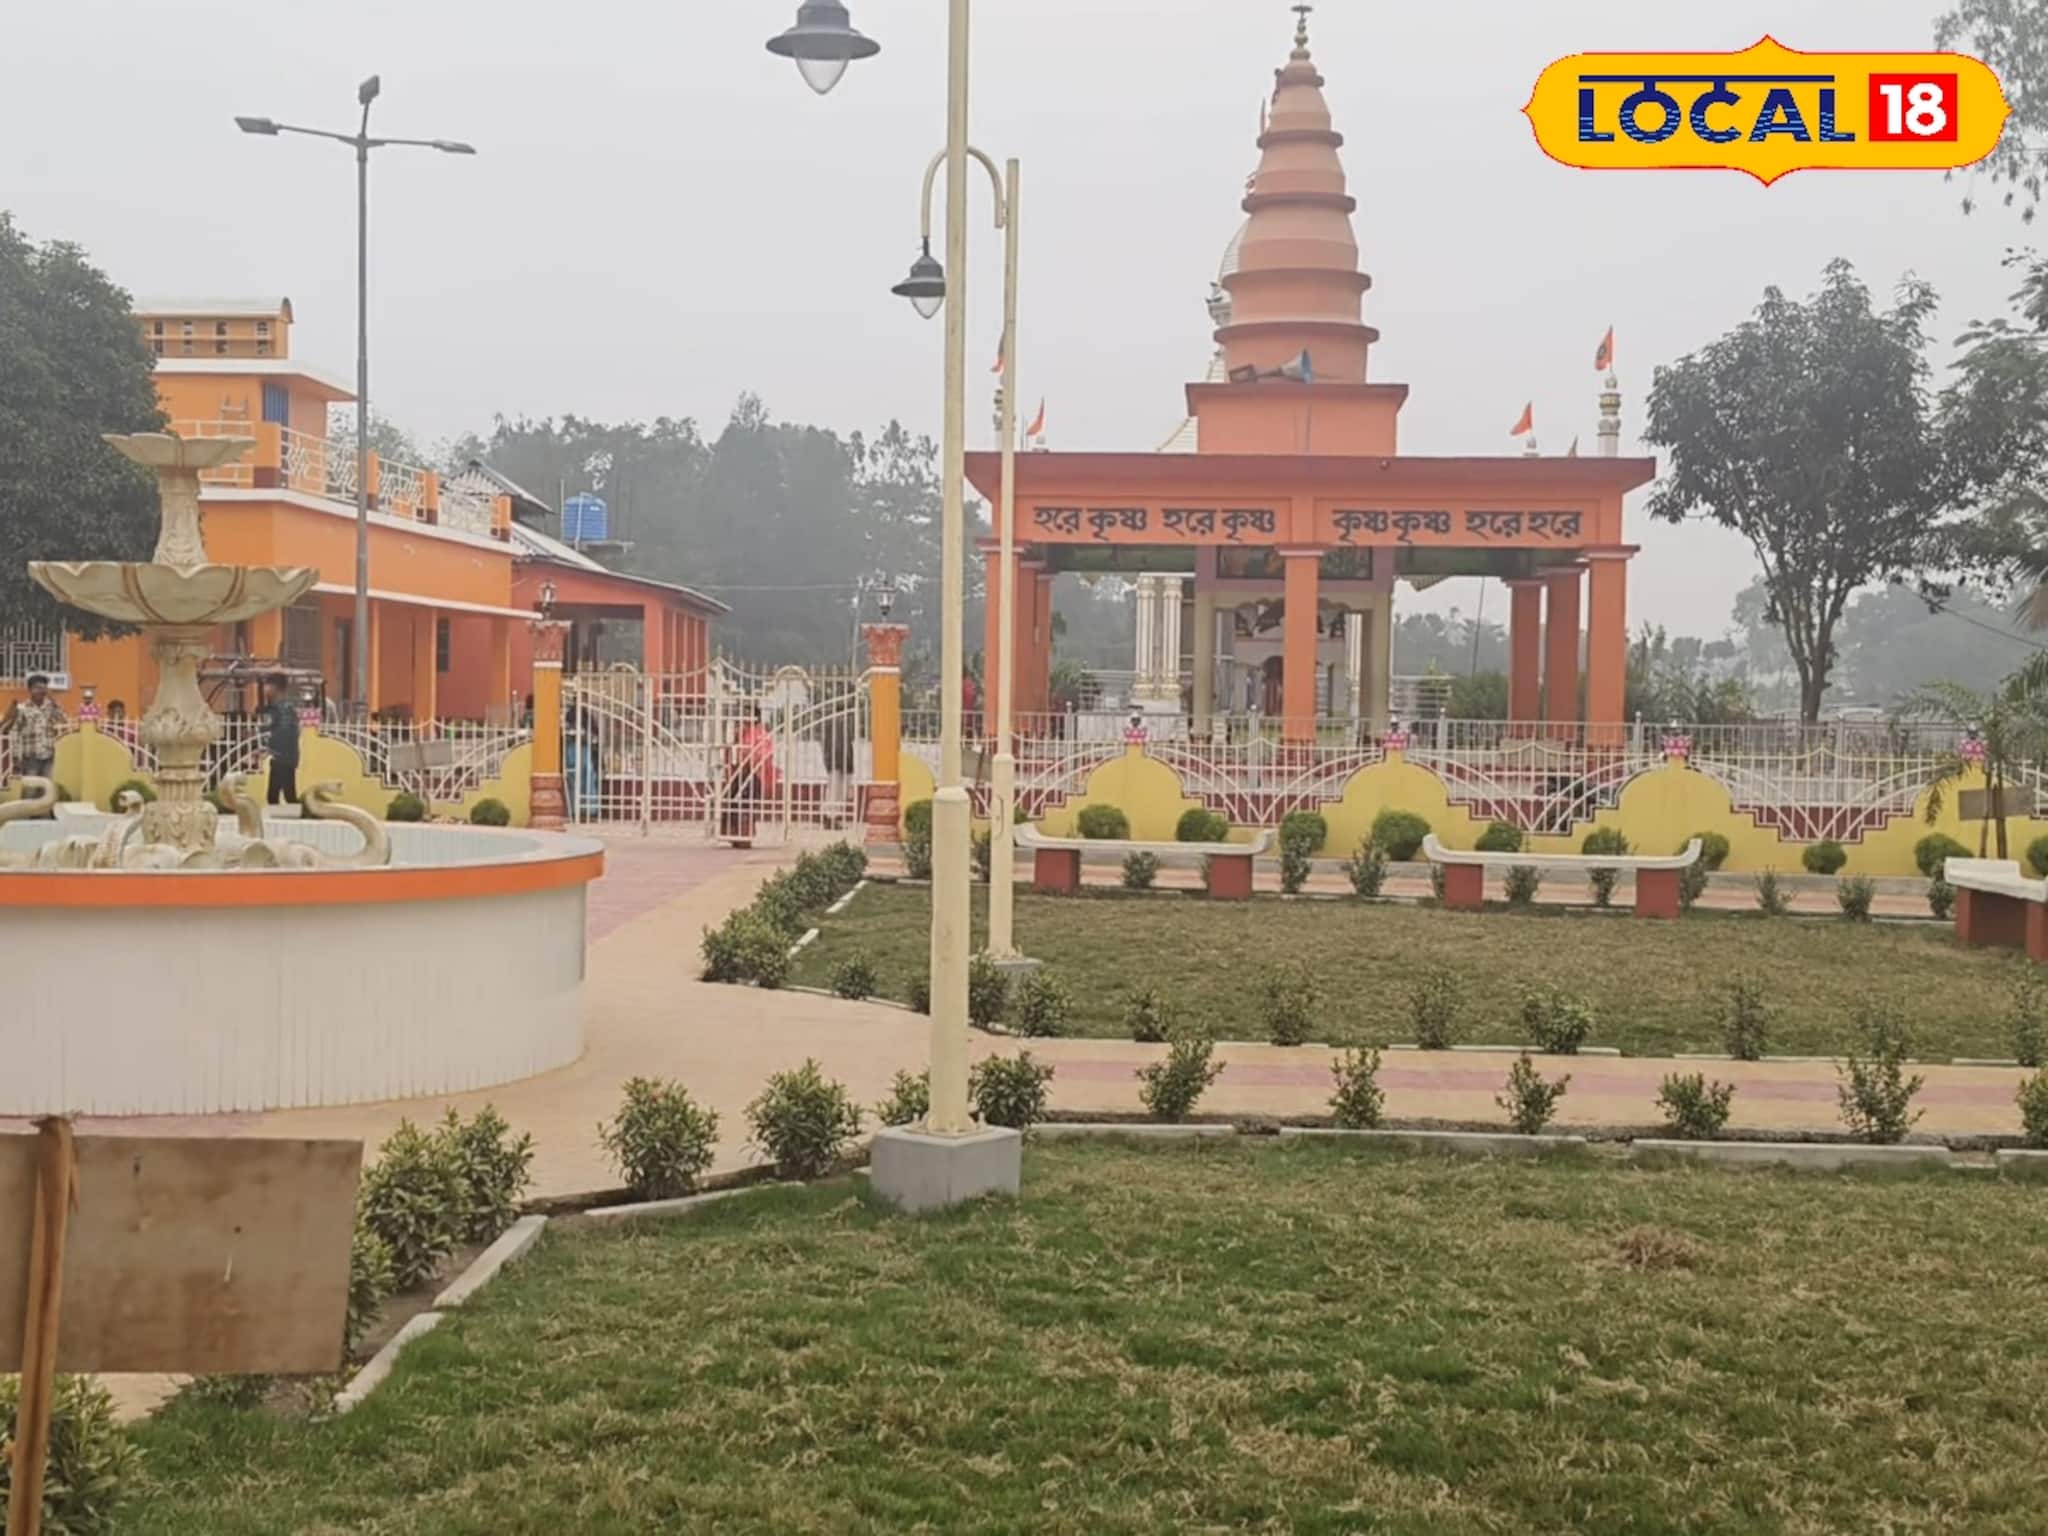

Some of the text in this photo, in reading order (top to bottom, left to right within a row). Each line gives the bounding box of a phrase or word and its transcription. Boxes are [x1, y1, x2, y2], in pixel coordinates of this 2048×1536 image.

[1033, 506, 1276, 542] হরে কৃষ্ণ হরে কৃষ্ণ
[1331, 509, 1582, 545] কৃষ্ণ কৃষ্ণ হরে হরে
